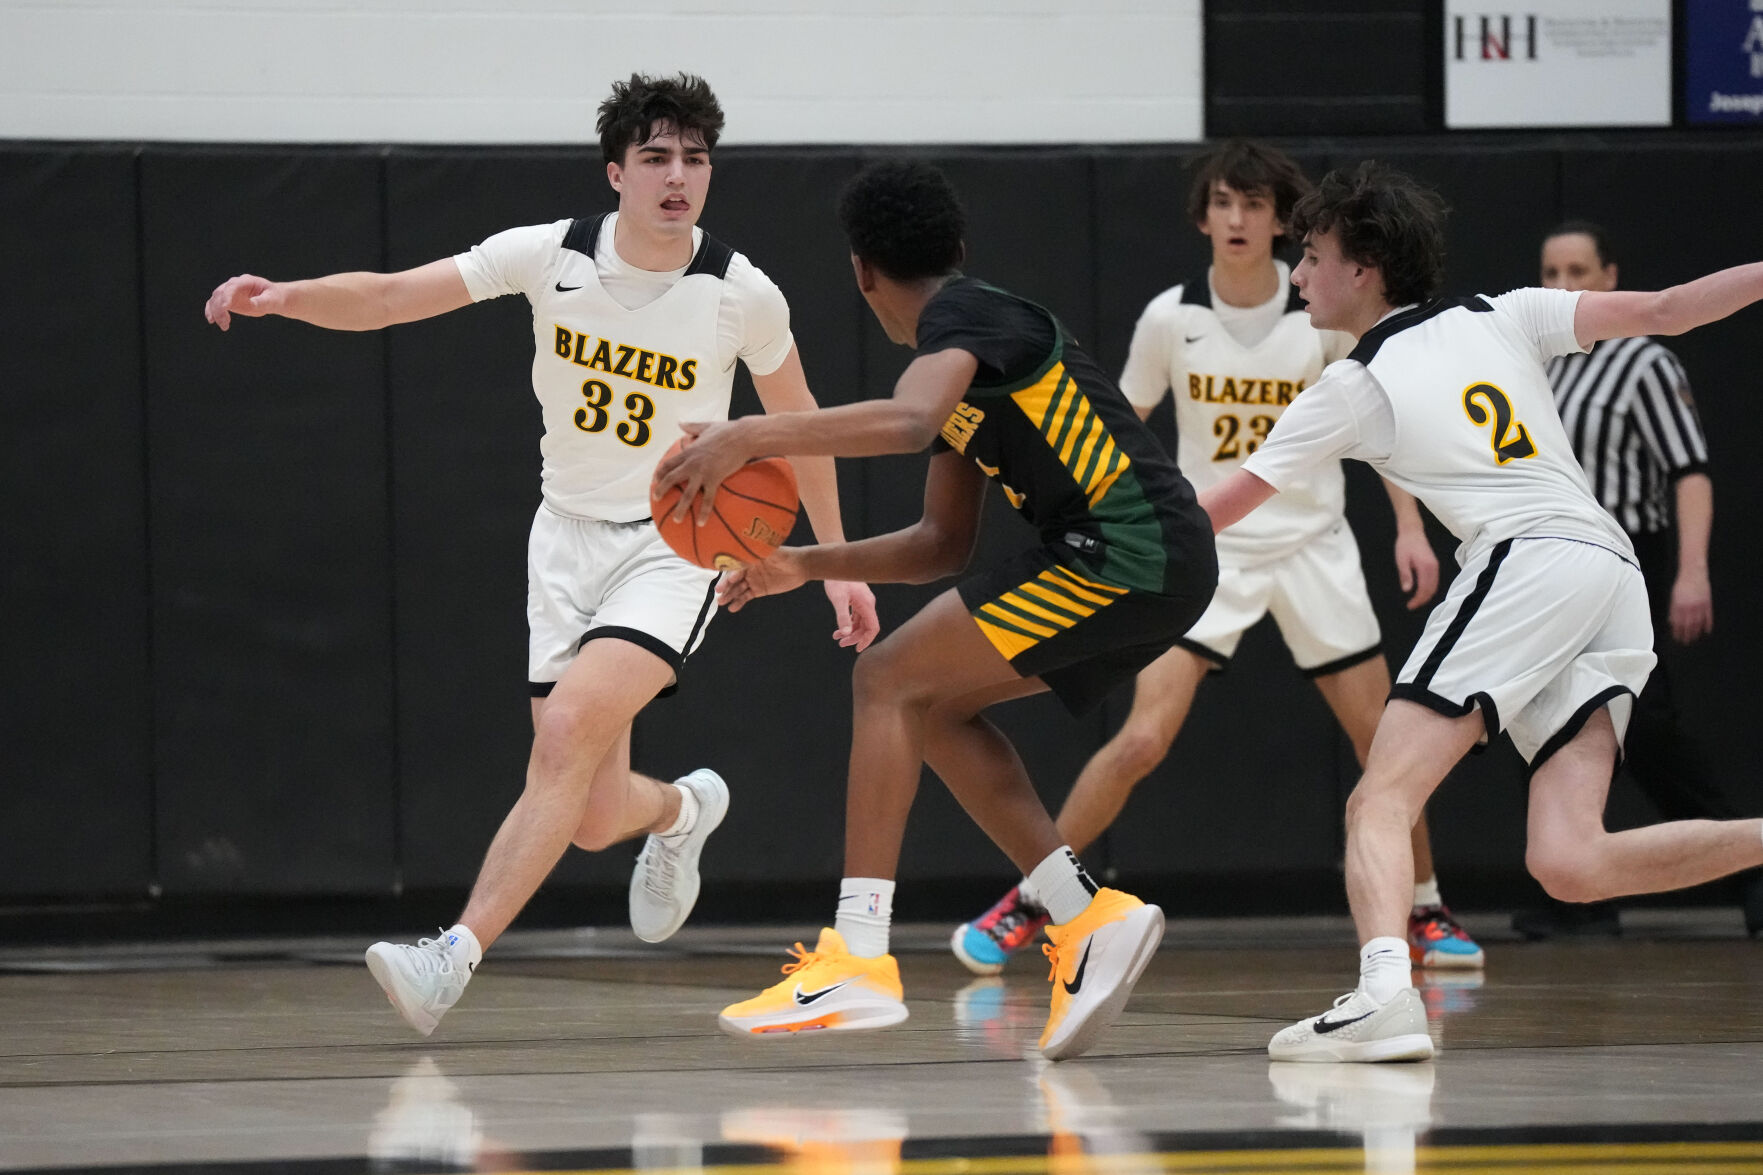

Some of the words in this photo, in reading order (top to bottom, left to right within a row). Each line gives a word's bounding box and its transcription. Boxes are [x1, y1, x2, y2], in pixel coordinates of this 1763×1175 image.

[553, 324, 698, 391] BLAZERS
[573, 378, 656, 448] 33
[1462, 381, 1538, 466] 2
